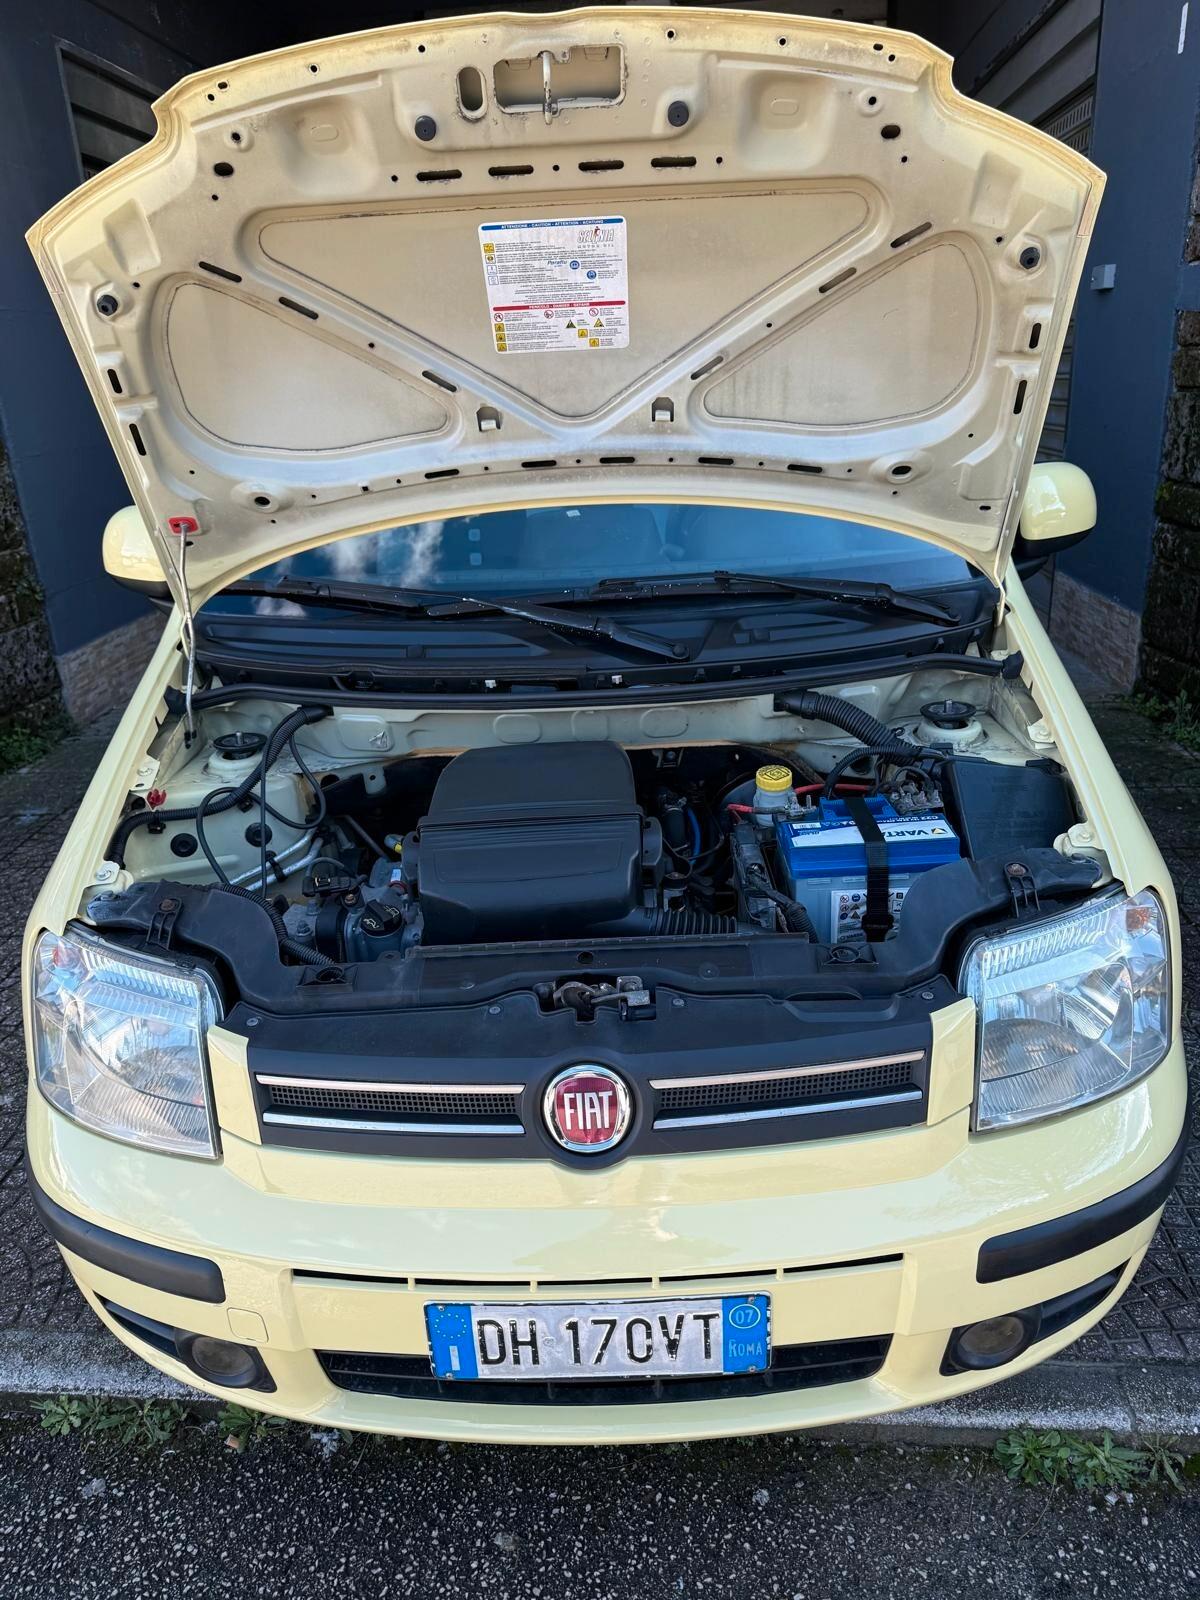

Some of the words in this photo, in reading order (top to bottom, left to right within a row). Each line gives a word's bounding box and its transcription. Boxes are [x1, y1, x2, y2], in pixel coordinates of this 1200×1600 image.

[563, 1090, 613, 1130] FIAT
[735, 1309, 754, 1324] 07
[476, 1318, 541, 1366] DH
